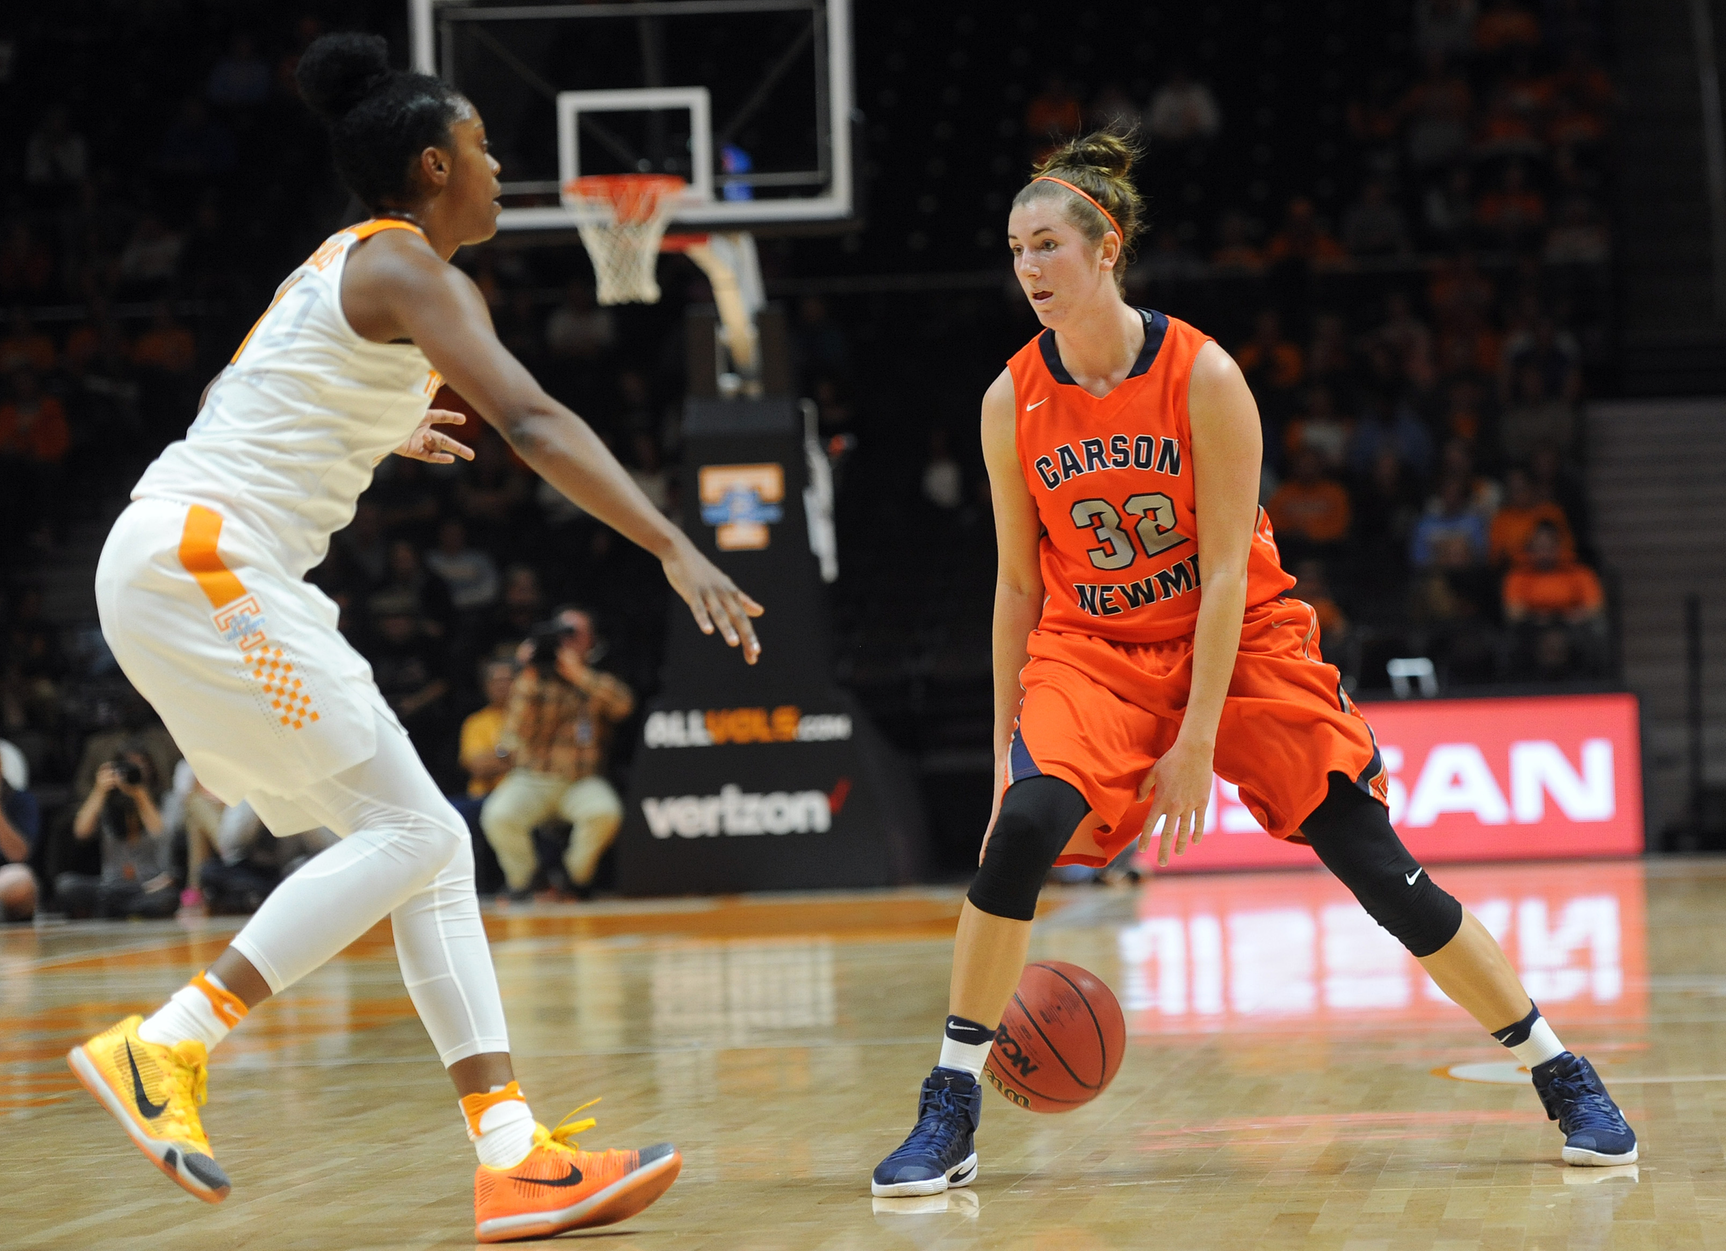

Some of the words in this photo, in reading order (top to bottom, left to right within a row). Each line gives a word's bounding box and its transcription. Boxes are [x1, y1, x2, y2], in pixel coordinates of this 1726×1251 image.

[1034, 434, 1182, 491] CARSON
[1069, 491, 1191, 571] 32
[641, 783, 833, 839] verizon
[995, 1022, 1039, 1077] NCA
